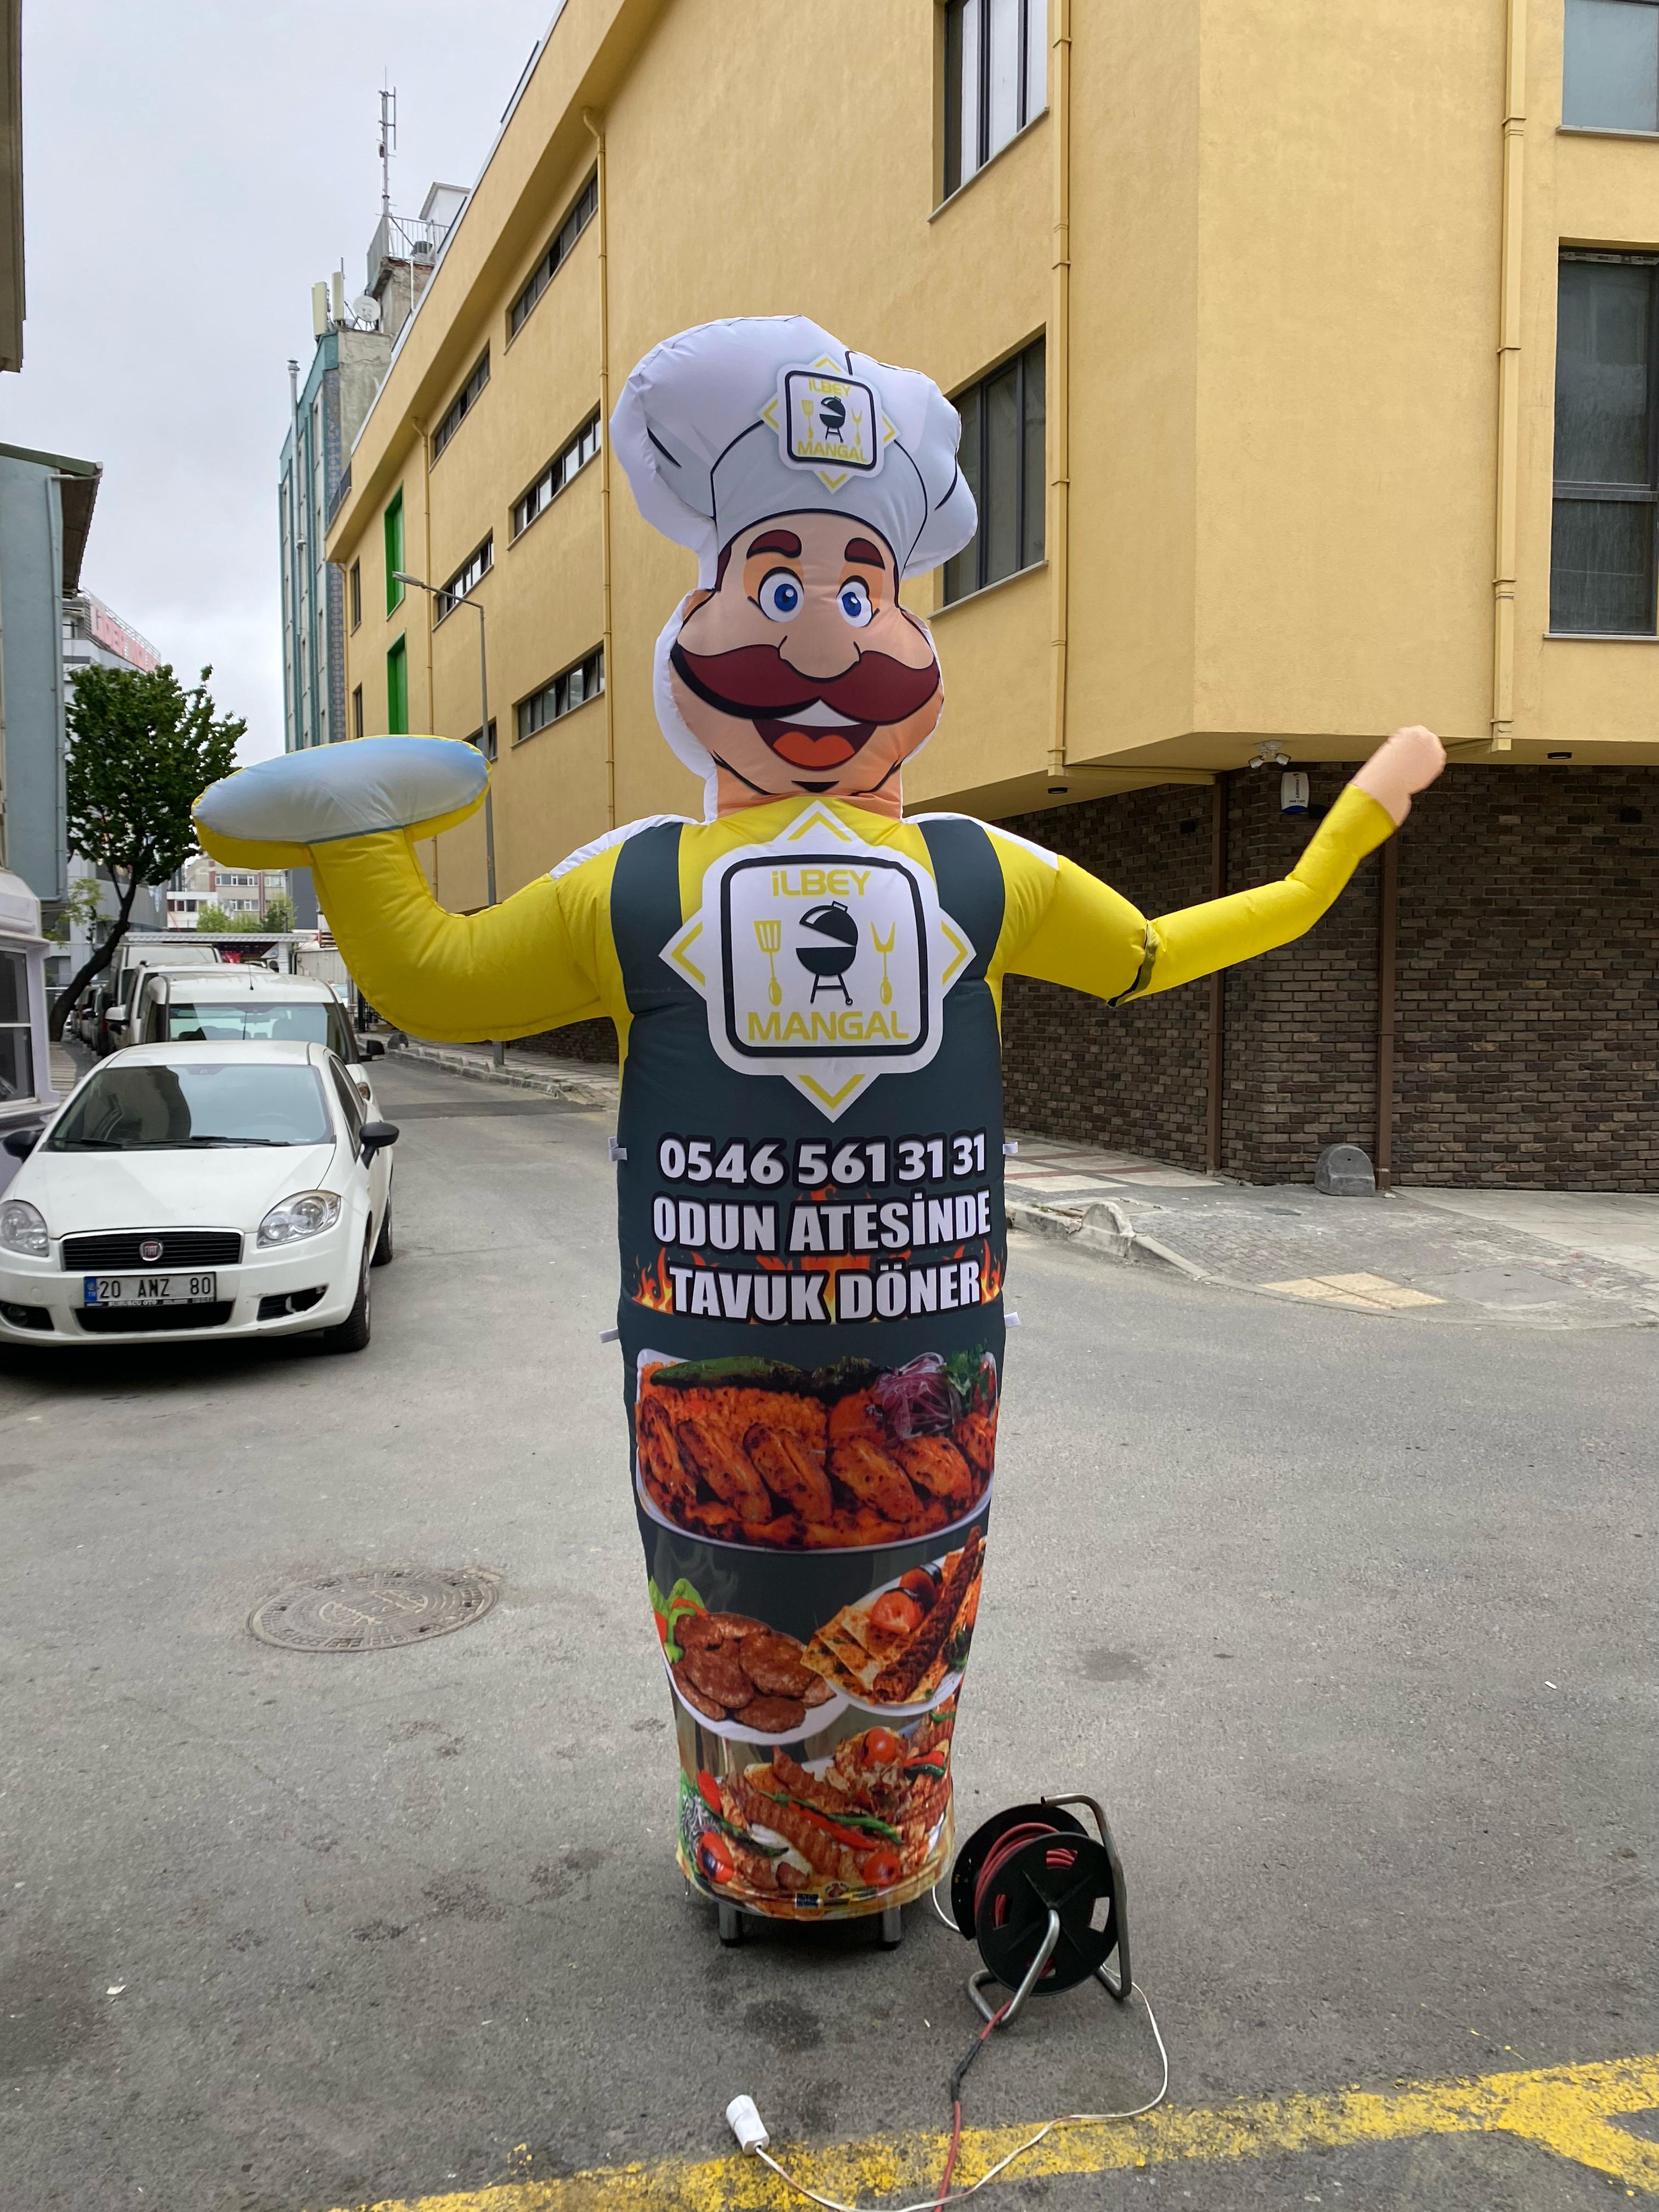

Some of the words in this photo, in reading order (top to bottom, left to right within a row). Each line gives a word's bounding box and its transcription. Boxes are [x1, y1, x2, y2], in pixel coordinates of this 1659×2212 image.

[797, 441, 867, 463] MANGAL
[747, 1011, 909, 1041] MANGAL
[659, 1137, 785, 1184] 0546
[798, 1142, 885, 1184] 561
[898, 1140, 944, 1180] 31
[952, 1133, 985, 1176] 31
[653, 1195, 776, 1251] ODUN
[99, 1280, 121, 1299] 20
[138, 1279, 170, 1297] ANZ
[190, 1277, 211, 1295] 80
[669, 1266, 827, 1321] TAVUK
[839, 1261, 980, 1319] DÖNER
